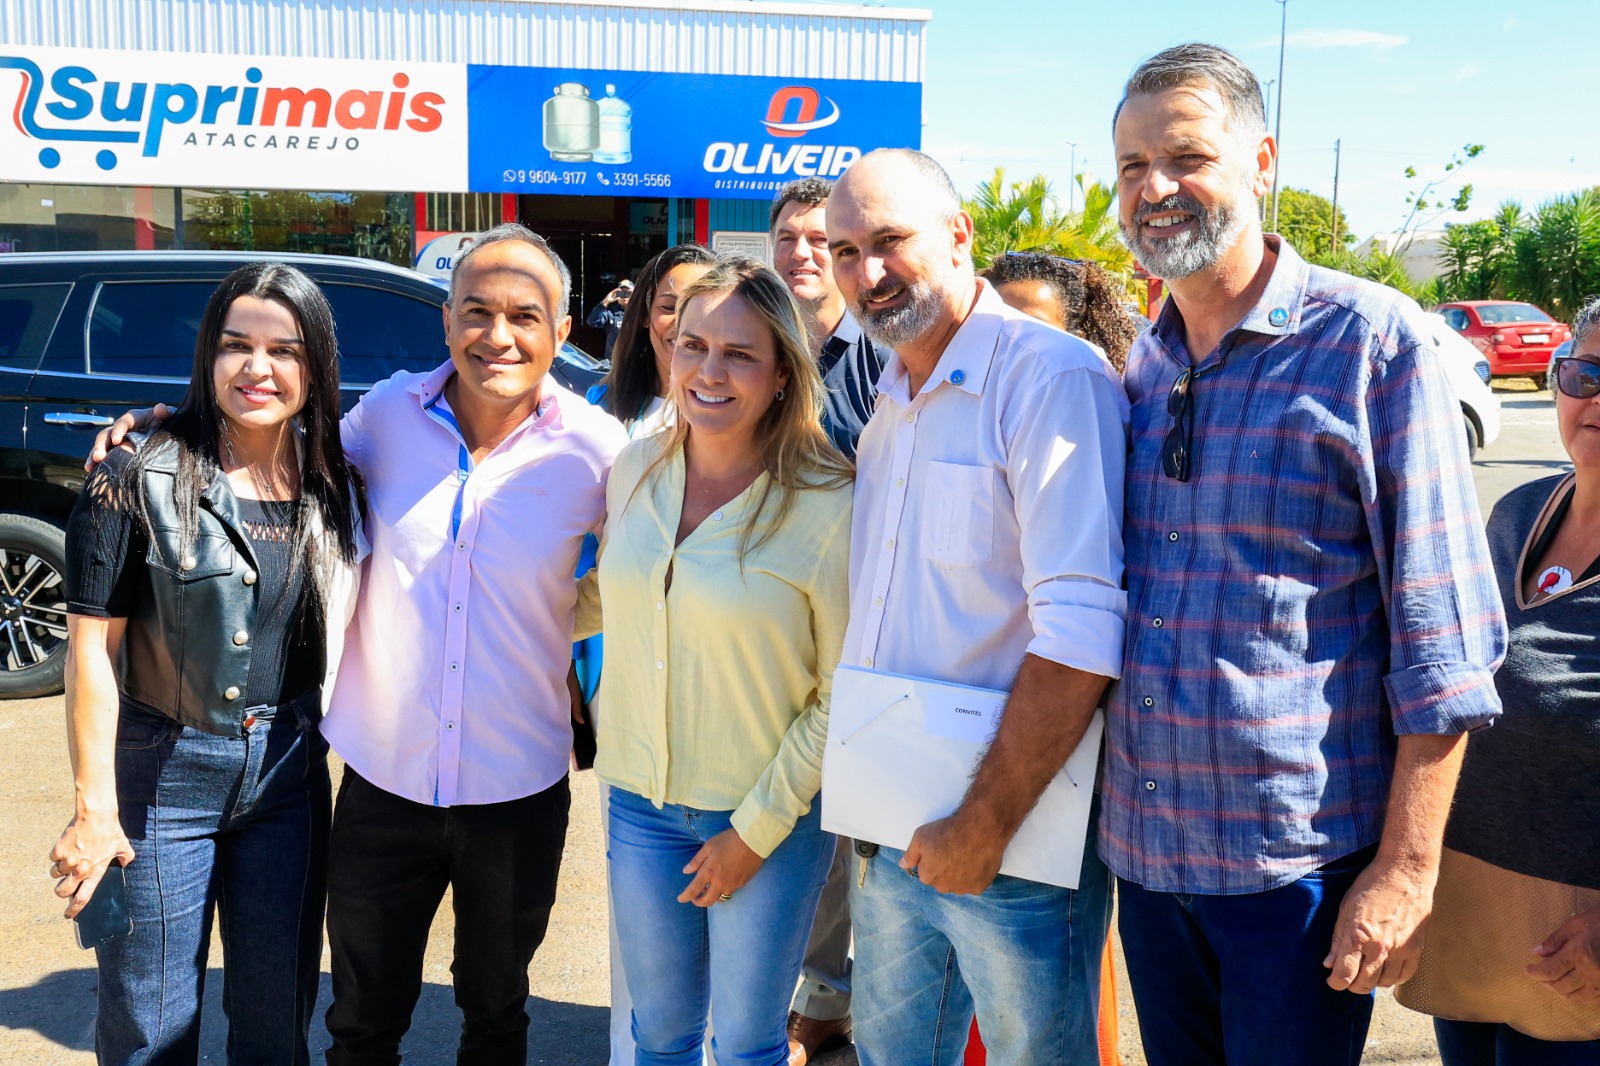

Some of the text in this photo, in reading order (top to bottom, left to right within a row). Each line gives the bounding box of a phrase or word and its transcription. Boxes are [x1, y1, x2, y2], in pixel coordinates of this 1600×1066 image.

[45, 65, 446, 158] Suprimais
[183, 131, 360, 151] ATACAREJO
[702, 141, 862, 177] OLIVEIR
[517, 169, 672, 187] 9 9604-9177 3391-5566
[954, 707, 982, 716] CONVITES
